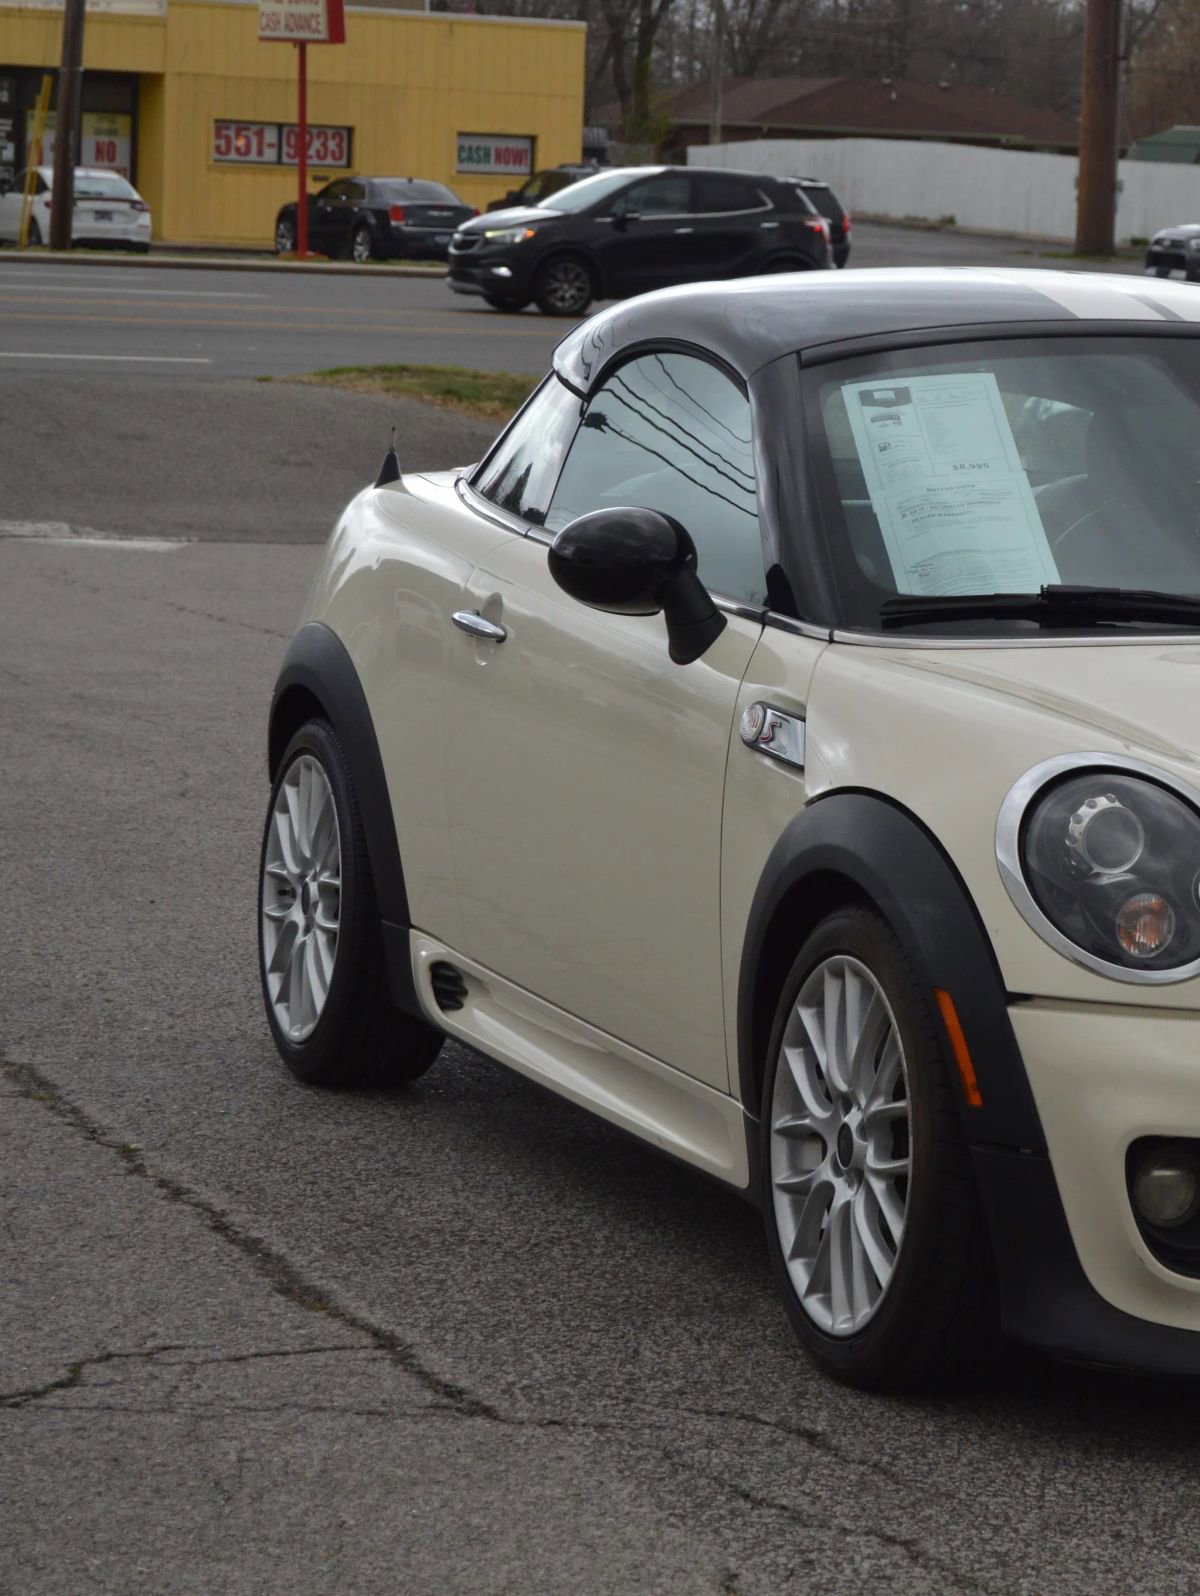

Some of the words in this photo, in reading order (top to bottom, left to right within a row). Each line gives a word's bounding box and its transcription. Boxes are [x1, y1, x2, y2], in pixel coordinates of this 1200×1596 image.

[259, 10, 281, 33] CASH
[283, 11, 322, 35] ADVANCE
[95, 139, 117, 164] NO
[457, 144, 492, 165] CASH
[494, 145, 529, 167] NOW!
